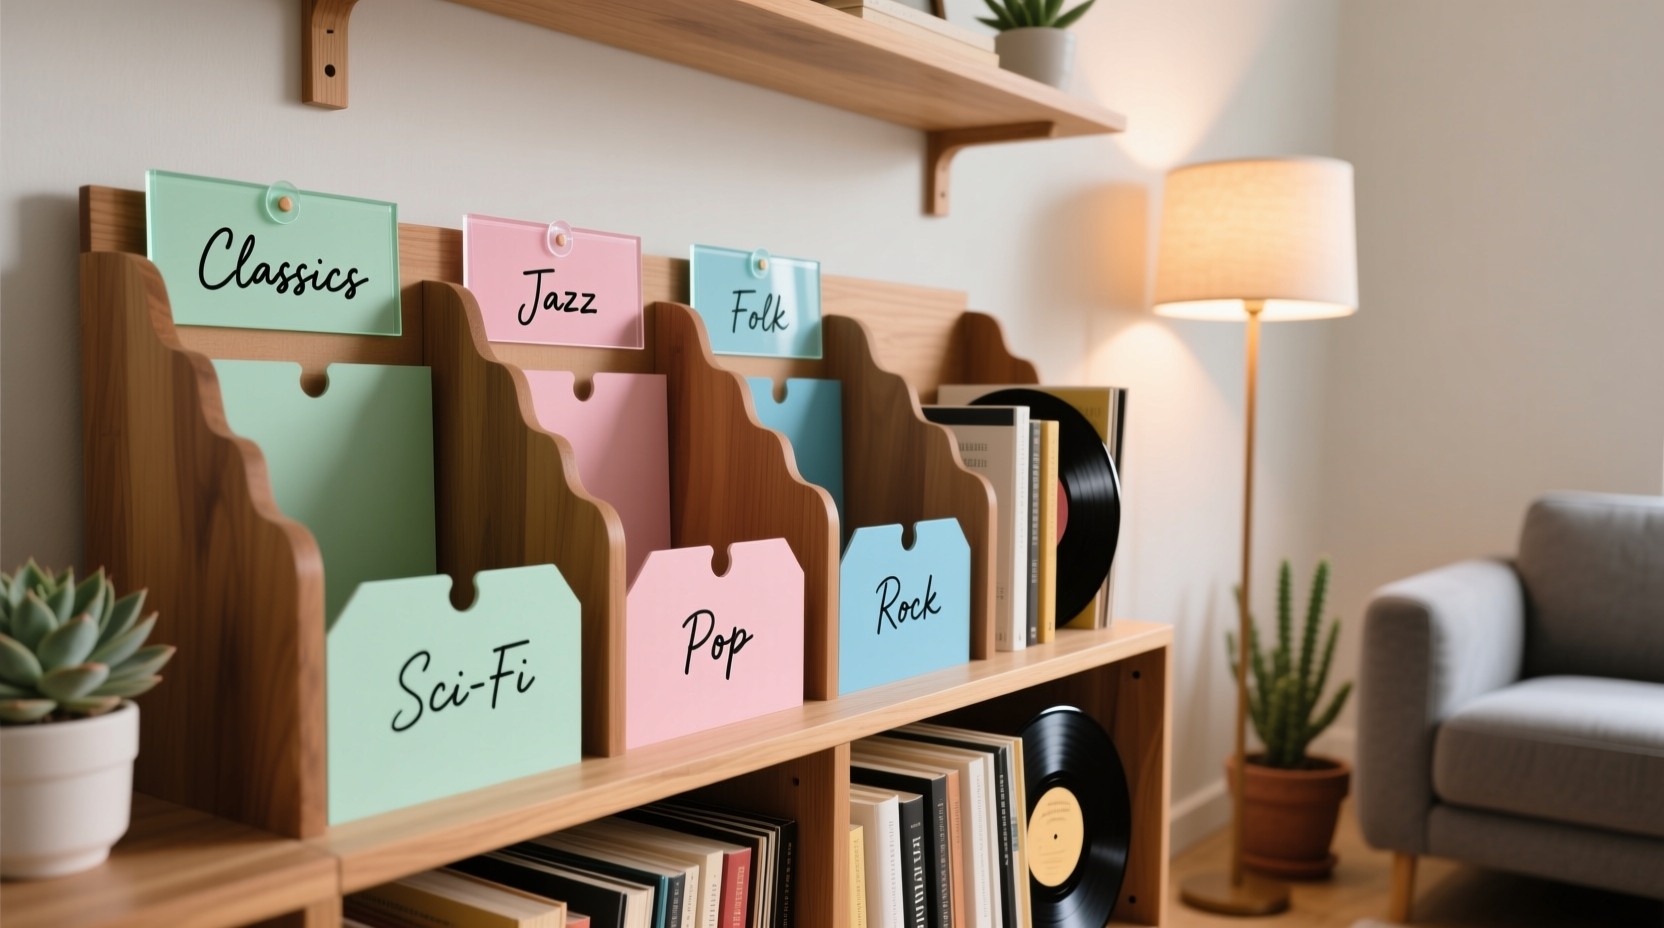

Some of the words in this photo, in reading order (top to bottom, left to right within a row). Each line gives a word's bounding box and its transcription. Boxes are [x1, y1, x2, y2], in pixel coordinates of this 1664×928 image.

[199, 227, 370, 299] Classics
[518, 268, 598, 326] Jazz
[731, 289, 789, 334] Folk
[876, 574, 942, 636] Rock
[682, 609, 755, 680] Pop
[391, 640, 535, 732] Sci-Fi
